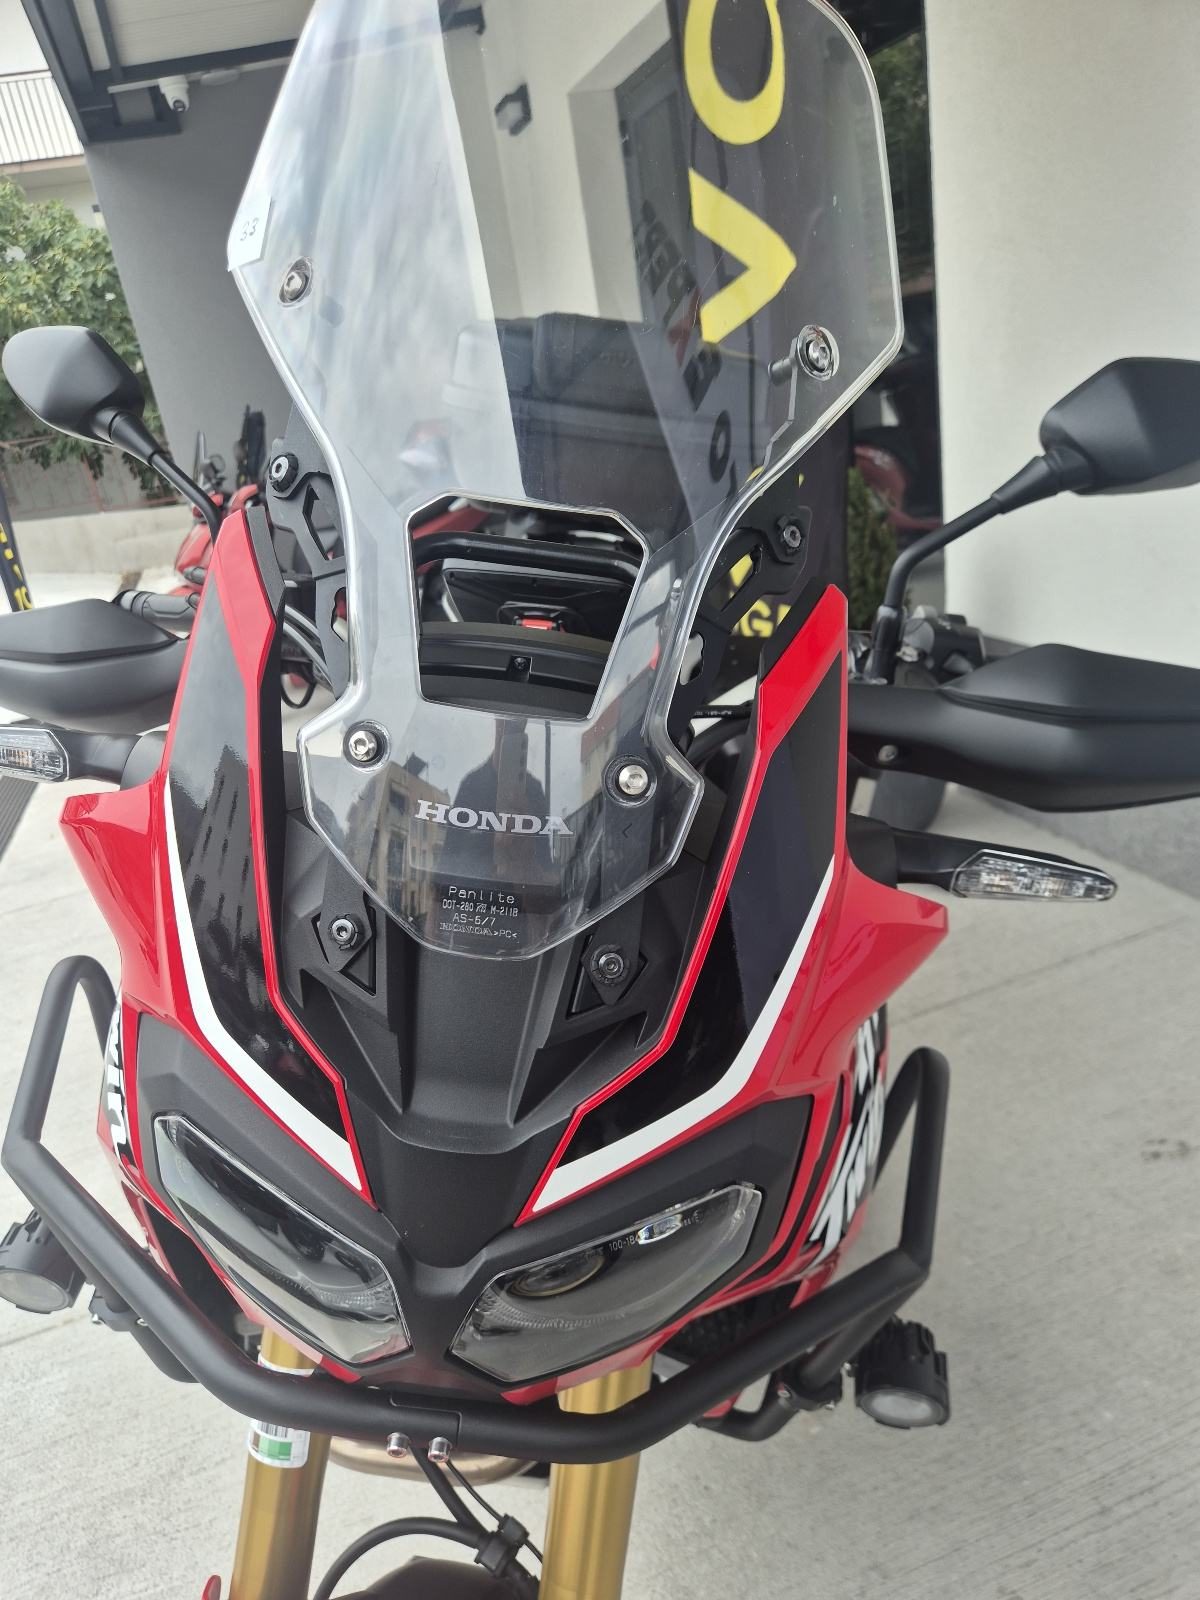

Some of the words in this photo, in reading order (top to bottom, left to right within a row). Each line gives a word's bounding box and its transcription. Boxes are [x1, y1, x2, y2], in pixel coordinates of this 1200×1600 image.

[414, 799, 574, 836] HONDA
[448, 885, 515, 904] Panlite
[452, 912, 496, 927] AS-6/7
